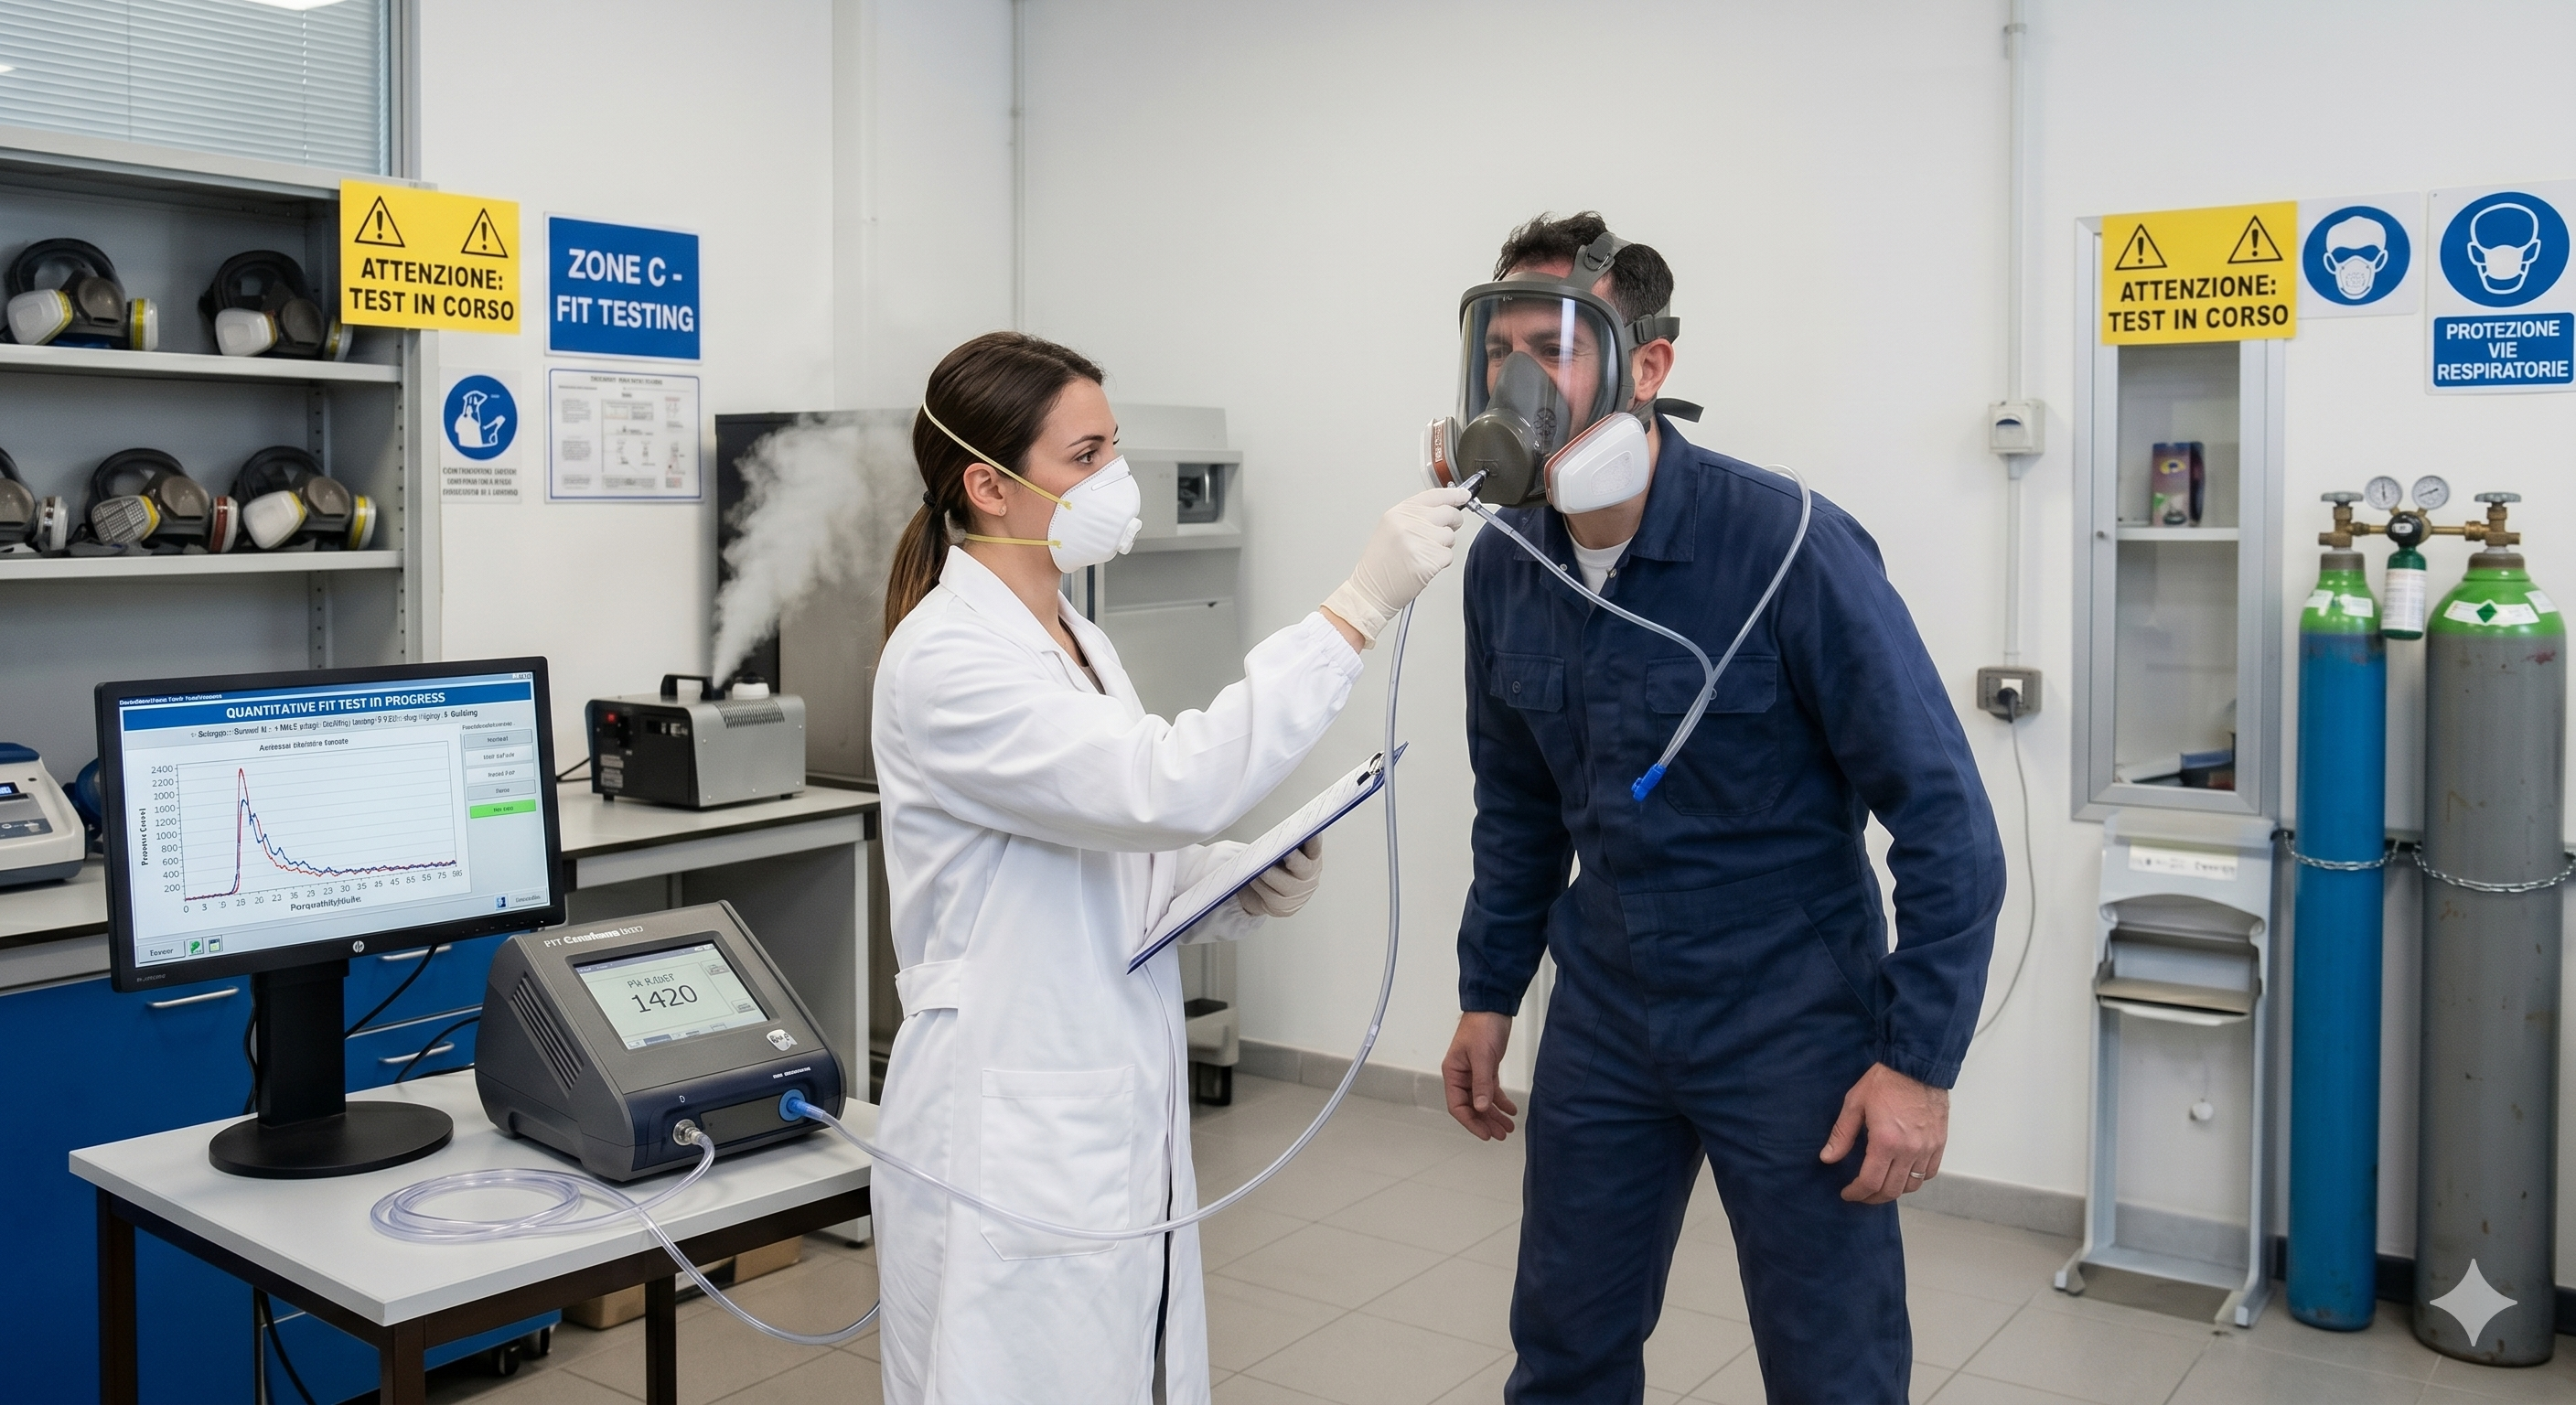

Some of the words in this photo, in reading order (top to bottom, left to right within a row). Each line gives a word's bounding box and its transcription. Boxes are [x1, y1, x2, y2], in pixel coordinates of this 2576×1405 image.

[361, 258, 504, 291] ATTENZIONE:
[568, 249, 641, 285] ZONE
[648, 257, 666, 287] C
[2120, 274, 2276, 303] ATTENZIONE:
[349, 287, 405, 313] TEST
[414, 293, 435, 316] IN
[444, 296, 514, 322] CORSO
[556, 295, 593, 324] FIT
[597, 299, 694, 333] TESTING
[2109, 310, 2165, 333] TEST
[2174, 308, 2197, 329] IN
[2206, 304, 2289, 328] CORSO
[2446, 320, 2560, 340] PROTEZIONE
[2488, 341, 2517, 359] VIE
[2437, 360, 2569, 381] RESPIRATORIE
[226, 701, 317, 719] QUANTITATIVE
[318, 700, 336, 712] FIT
[338, 697, 367, 711] TEST
[385, 692, 445, 707] PROGRESS
[151, 766, 173, 774] 2400
[152, 778, 174, 787] 2200
[154, 791, 175, 800] 2000
[156, 818, 177, 827] 1200
[156, 831, 177, 840] 1000
[161, 844, 177, 853] 800
[162, 857, 178, 865] 600
[163, 870, 179, 879] 400
[164, 884, 180, 893] 200
[340, 885, 350, 893] 30
[631, 984, 698, 1013] 1420
